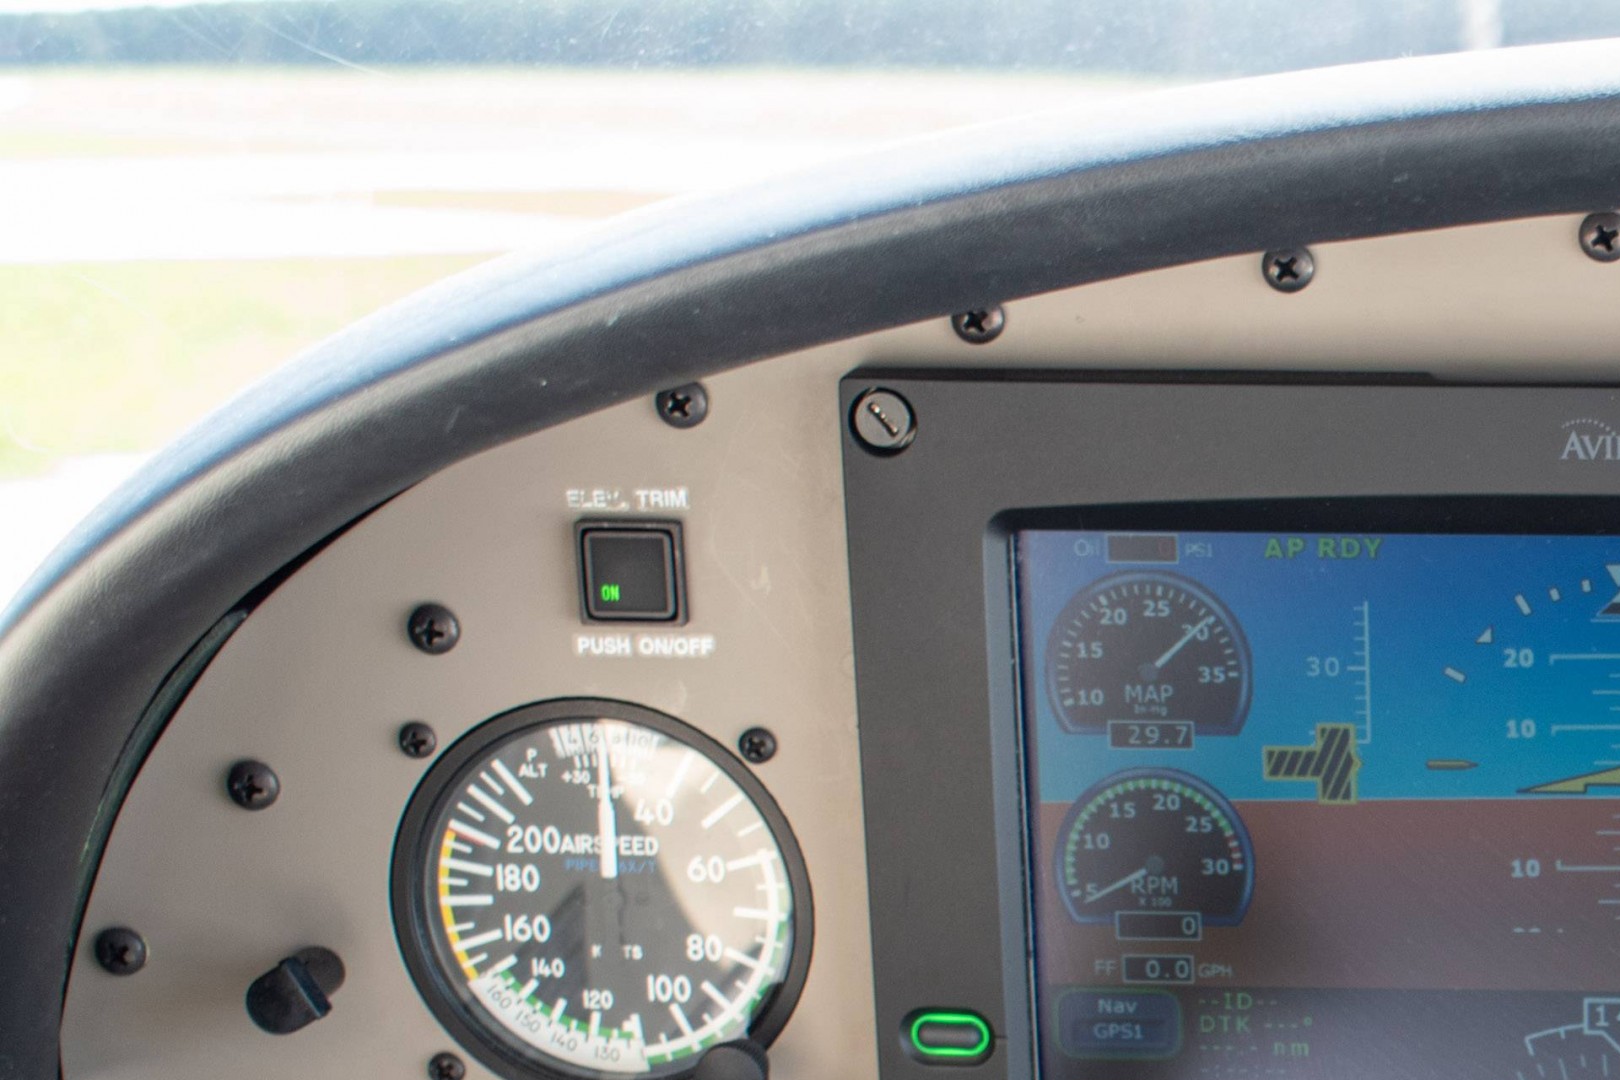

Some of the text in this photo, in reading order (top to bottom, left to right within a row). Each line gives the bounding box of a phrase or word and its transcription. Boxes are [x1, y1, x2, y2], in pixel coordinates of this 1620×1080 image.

[1264, 538, 1382, 558] AP RDY
[601, 585, 620, 601] ON
[1144, 600, 1169, 616] 25
[1100, 609, 1126, 625] 20
[577, 636, 714, 655] PUSH ON/OFF
[1077, 642, 1102, 657] 15
[1307, 657, 1339, 676] 30
[1504, 649, 1534, 667] 20
[1199, 668, 1226, 683] 35
[1125, 686, 1172, 702] MAP
[1128, 727, 1187, 743] 29.7
[1507, 720, 1535, 738] 10
[1110, 803, 1135, 818] 15
[1154, 795, 1180, 810] 20
[1186, 817, 1212, 832] 25
[508, 826, 559, 853] 200
[1083, 834, 1109, 849] 10
[688, 857, 724, 881] 60
[1202, 859, 1228, 874] 30
[1512, 859, 1539, 877] 10
[496, 865, 539, 890] 180
[504, 916, 550, 941] 160
[687, 938, 723, 961] 80
[532, 959, 564, 977] 140
[648, 976, 691, 1002] 100
[583, 991, 613, 1008] 120
